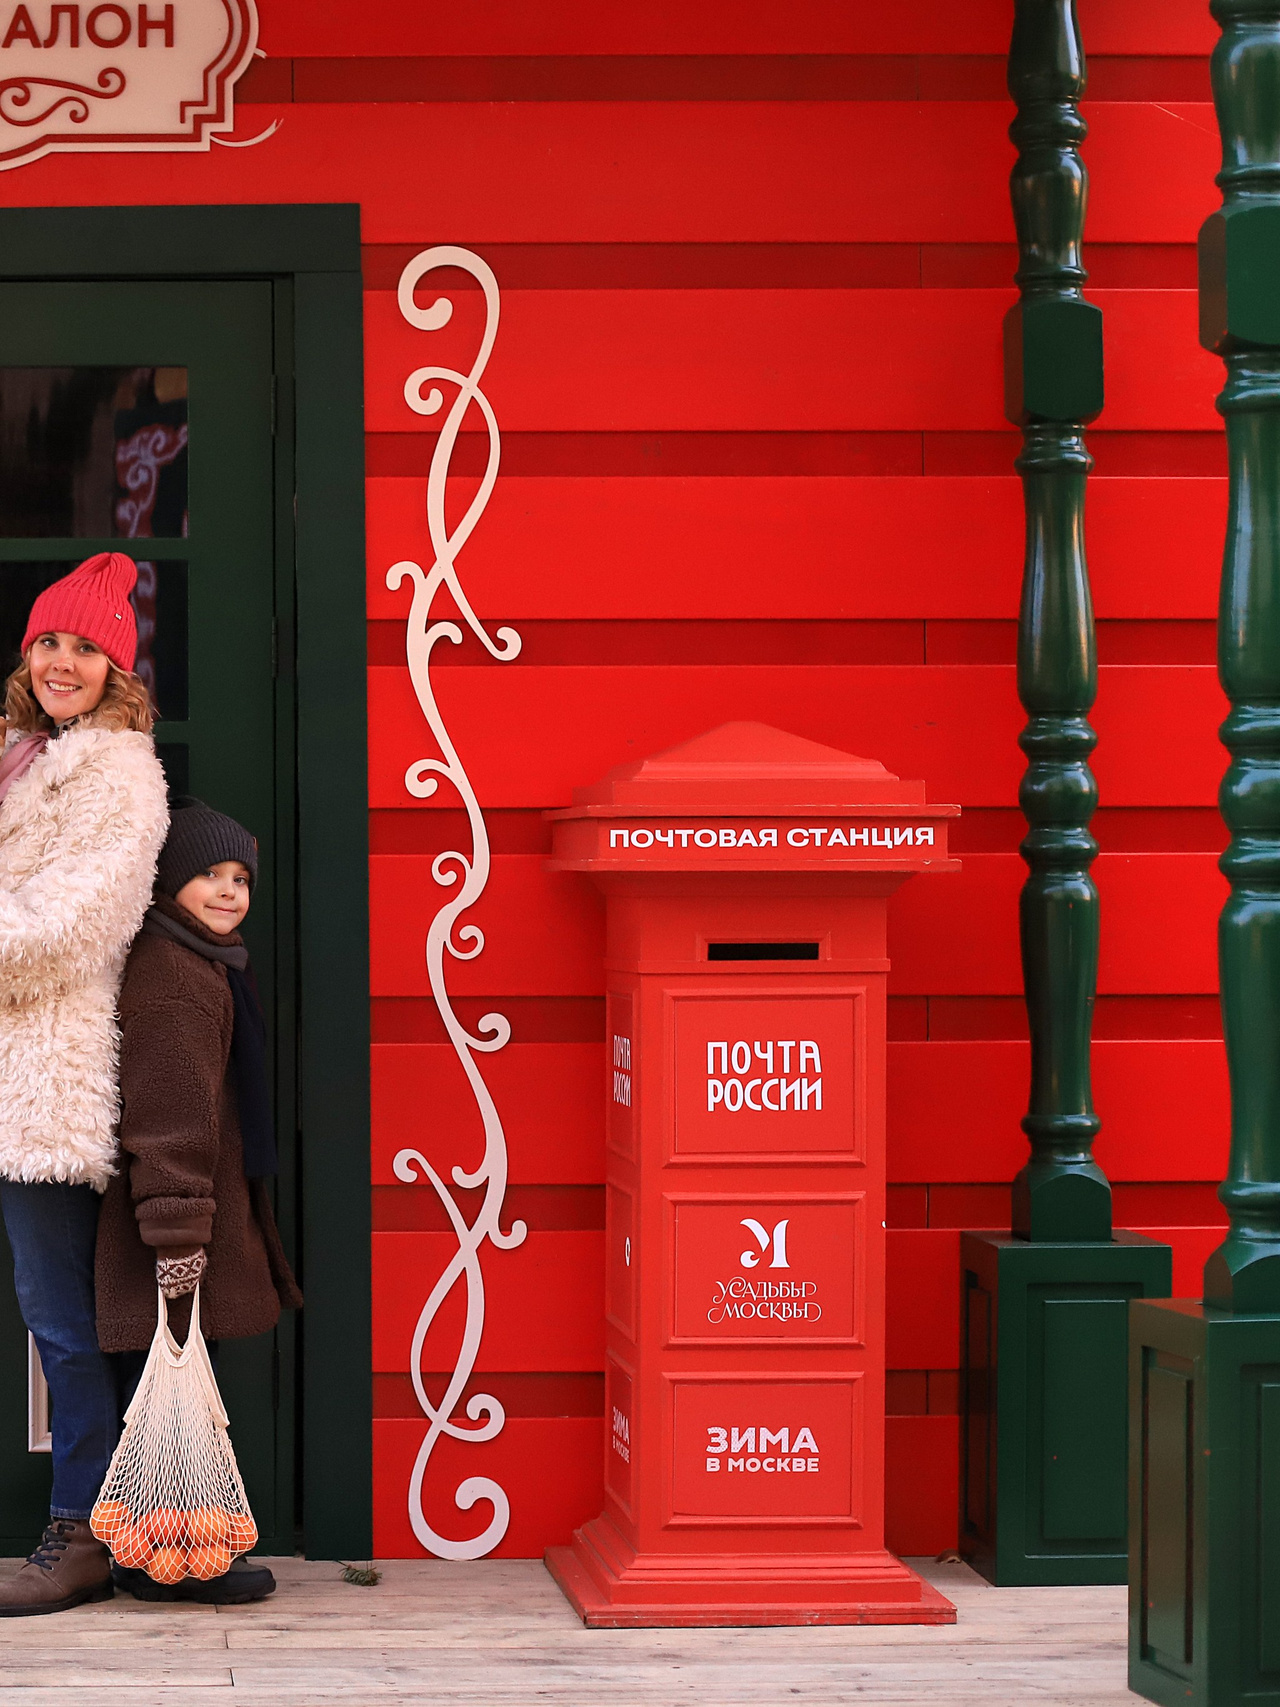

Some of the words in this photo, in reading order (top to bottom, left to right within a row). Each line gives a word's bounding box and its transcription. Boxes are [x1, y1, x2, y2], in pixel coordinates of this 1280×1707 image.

[609, 828, 778, 848] ПОЧТОВАЯ
[786, 827, 934, 849] СТАНЦИЯ
[707, 1040, 822, 1075] ПОЧТА
[707, 1077, 822, 1112] РОССИИ
[712, 1276, 818, 1304] УСАДЬБЫ
[707, 1302, 822, 1324] МОСКВЫ
[705, 1426, 820, 1454] ЗИМА
[706, 1457, 721, 1472] В
[727, 1457, 820, 1473] МОСКВЕ
